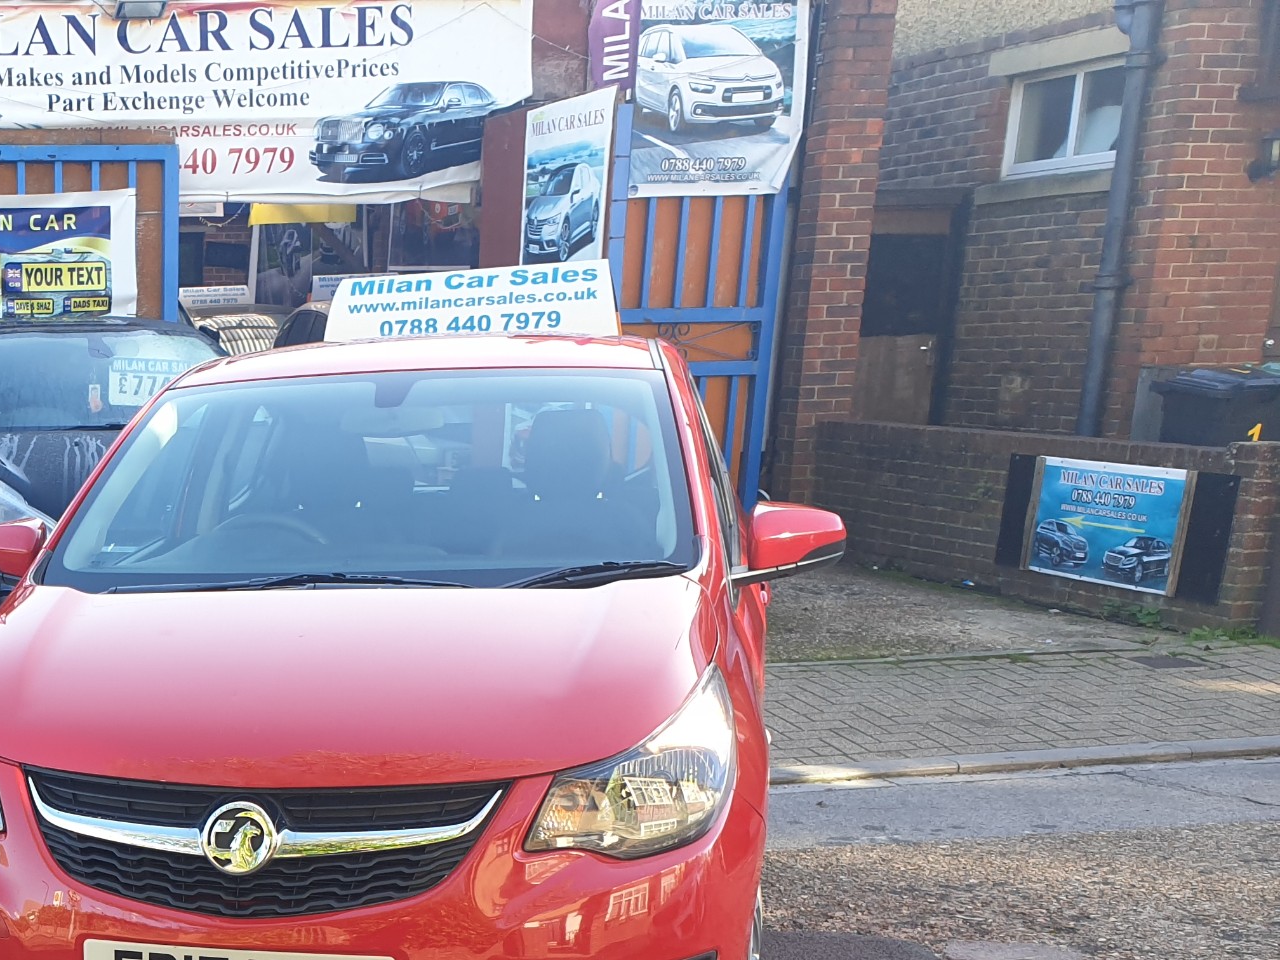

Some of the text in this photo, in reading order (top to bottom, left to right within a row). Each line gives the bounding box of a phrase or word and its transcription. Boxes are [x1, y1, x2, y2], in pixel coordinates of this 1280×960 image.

[641, 4, 792, 19] MILAN CAR SALES
[116, 11, 235, 54] CAR
[249, 4, 414, 51] SALES
[71, 66, 112, 86] and
[119, 63, 197, 85] Models
[47, 88, 310, 114] Part Exchenge Welcome
[531, 108, 605, 137] MILAN CAR SALES
[179, 146, 295, 174] 40 7979
[661, 157, 746, 171] 0788 440 7979
[29, 213, 78, 231] CAR
[24, 267, 63, 286] YOUR
[67, 266, 103, 286] TEXT
[350, 277, 432, 296] Milan
[444, 273, 500, 290] Car
[509, 267, 598, 286] Sales
[73, 300, 90, 309] DADS
[93, 299, 108, 308] TAXI
[348, 287, 598, 314] www.milancarsales.co.uk
[379, 310, 562, 336] 0788 440 7979
[112, 360, 191, 372] MILAN CAR SAL
[1060, 470, 1165, 495] MILAN CAR SALES
[1071, 488, 1136, 509] 0788 440 7979
